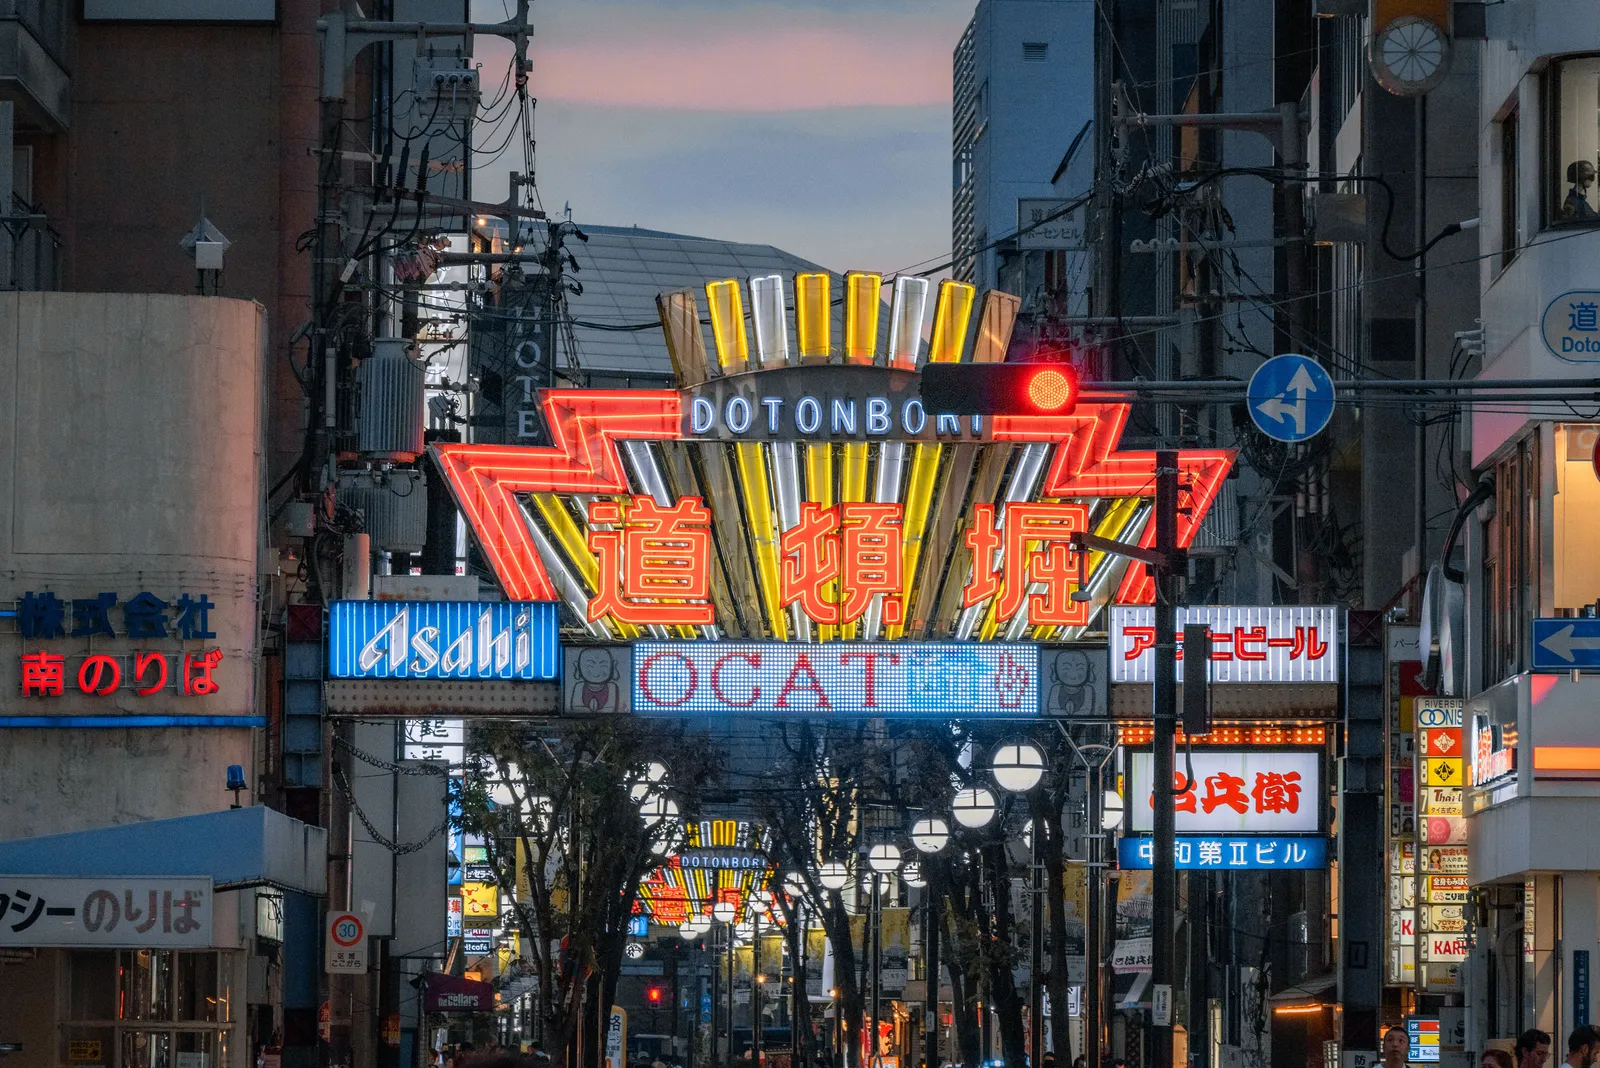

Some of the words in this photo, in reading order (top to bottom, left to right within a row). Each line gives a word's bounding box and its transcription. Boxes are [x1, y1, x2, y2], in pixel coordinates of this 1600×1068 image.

[587, 494, 1092, 626] 道頓堀
[19, 591, 216, 640] 株式会社
[359, 605, 531, 674] Asahi
[1123, 626, 1328, 660] アヒビール
[20, 650, 223, 697] 南のりば
[639, 652, 900, 708] OCAT
[339, 924, 356, 938] 30
[1402, 919, 1415, 935] K
[331, 959, 361, 967] ここから
[448, 993, 479, 1007] cellars
